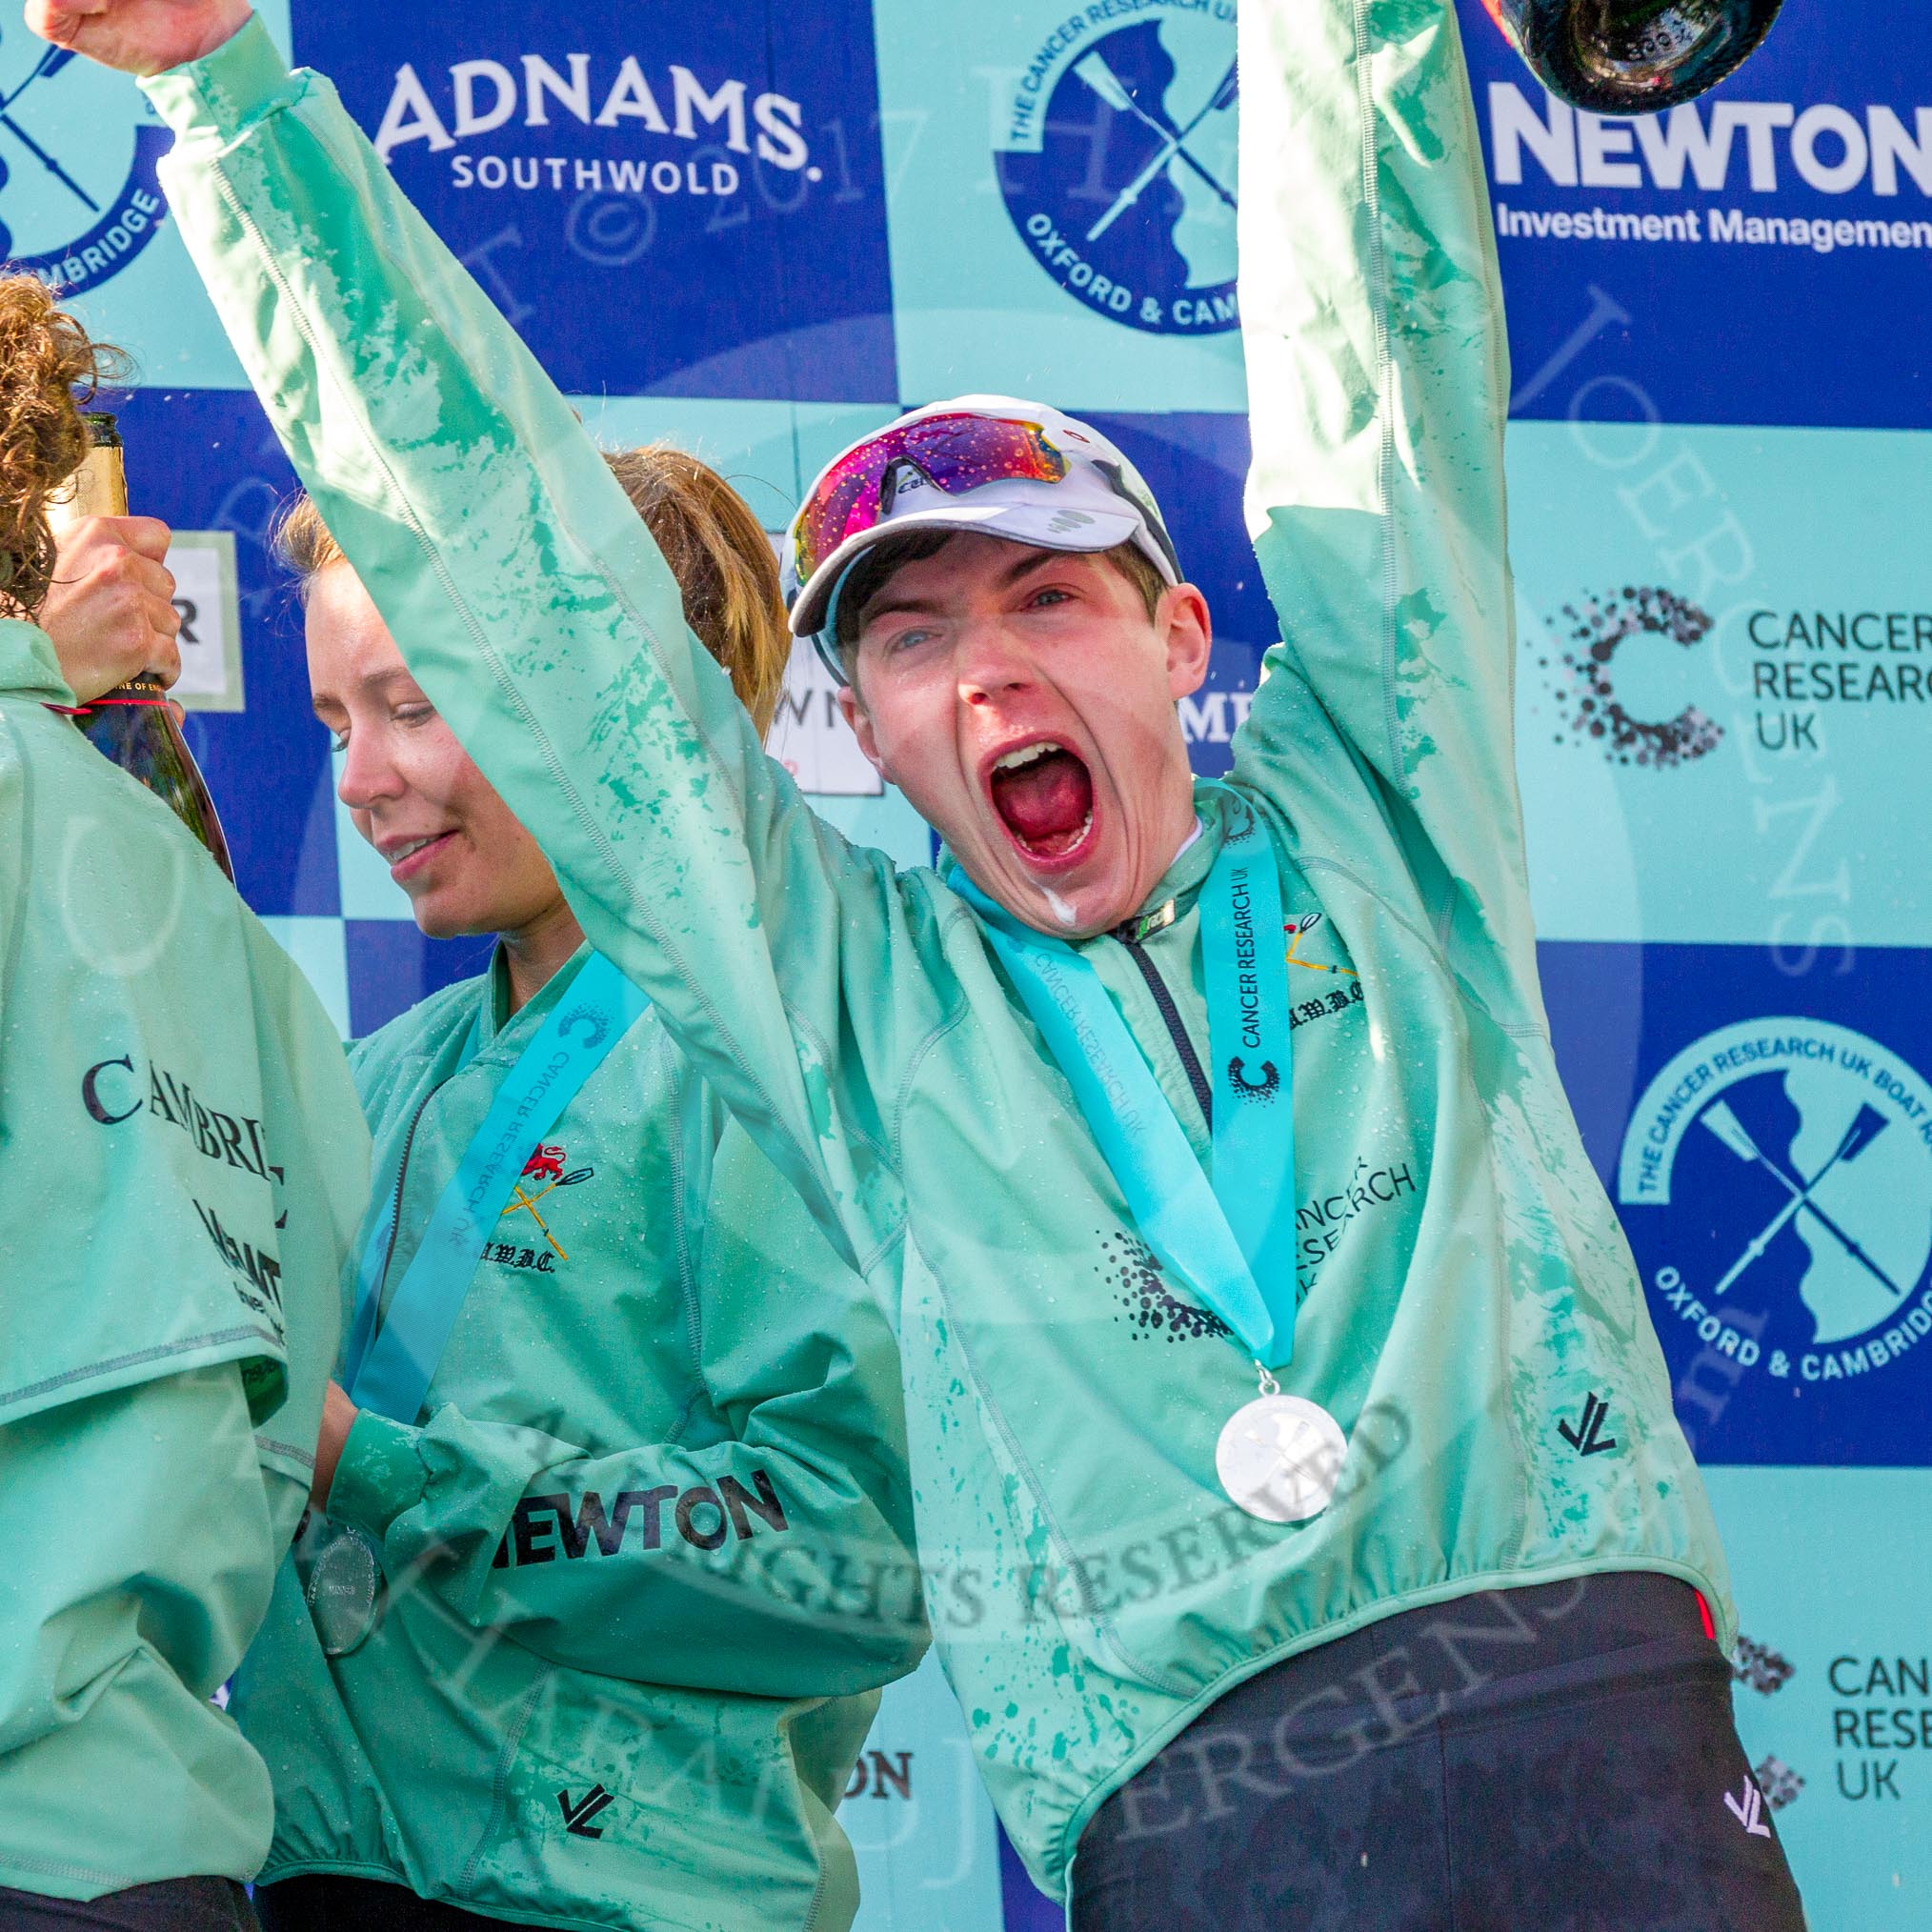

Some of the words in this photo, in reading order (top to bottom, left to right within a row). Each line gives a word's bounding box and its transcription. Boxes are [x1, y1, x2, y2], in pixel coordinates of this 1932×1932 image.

[1010, 91, 1036, 143] THE
[1023, 13, 1088, 90] CANCER
[1488, 82, 1932, 197] NEWTON
[452, 155, 739, 195] SOUTHWOLD
[1498, 203, 1701, 242] Investment
[1710, 209, 1932, 252] Managemen
[1027, 213, 1133, 312] OXFORD
[1139, 297, 1163, 324] &
[134, 682, 147, 691] OF
[1754, 662, 1932, 701] RESEAR
[1756, 712, 1819, 750] UK
[1231, 867, 1249, 881] UK
[1231, 884, 1257, 969] RESEARCH
[1239, 973, 1260, 1049] CANCER
[1713, 1036, 1835, 1074] RESEARCH
[1840, 1049, 1874, 1079] UK
[1649, 1064, 1715, 1142] CANCER
[1873, 1069, 1927, 1118] BOAT
[1638, 1147, 1663, 1193] THE
[1655, 1265, 1761, 1366] OXFORD
[1767, 1349, 1791, 1379] &
[1828, 1656, 1929, 1697] CAN
[1838, 1759, 1902, 1801] UK
